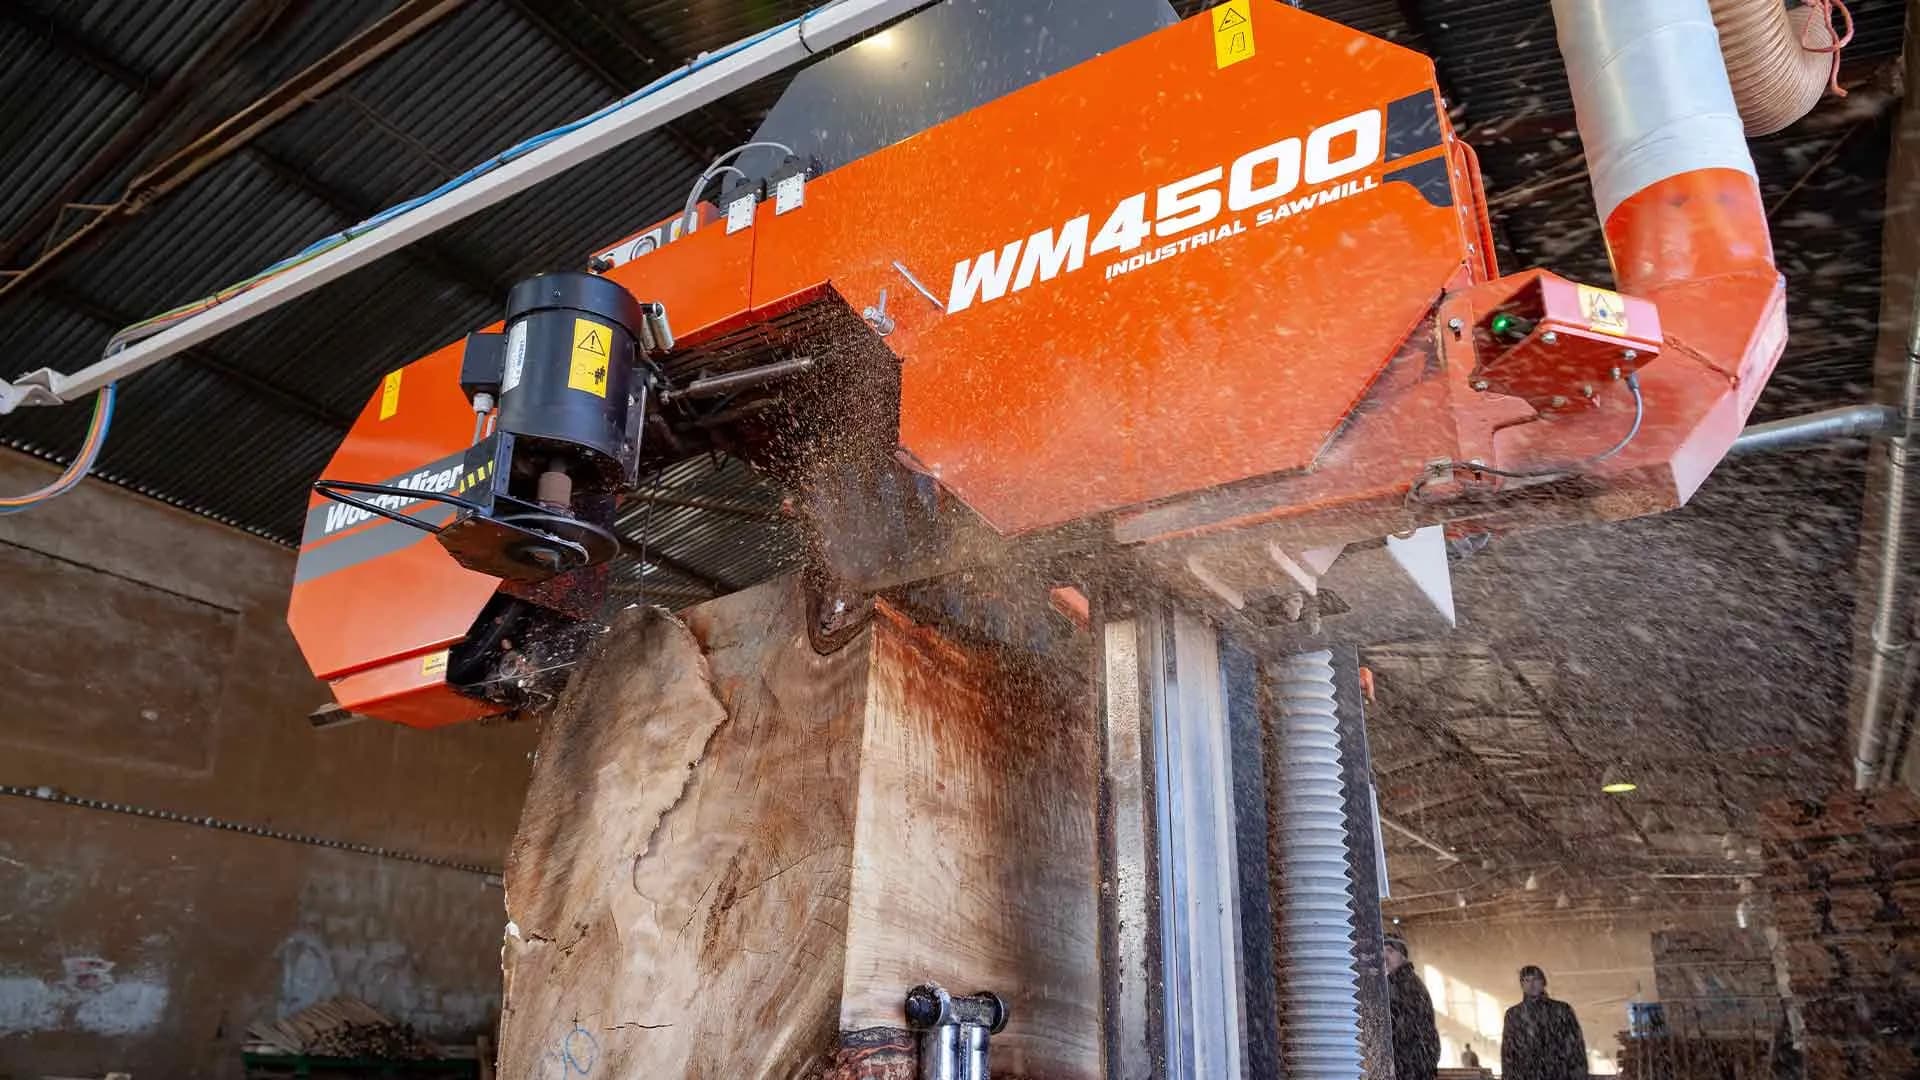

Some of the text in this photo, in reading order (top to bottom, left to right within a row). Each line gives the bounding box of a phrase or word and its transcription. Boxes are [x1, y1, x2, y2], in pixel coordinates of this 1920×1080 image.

[946, 108, 1382, 315] WM4500
[1105, 176, 1380, 280] INDUSTRIAL SAWMILL
